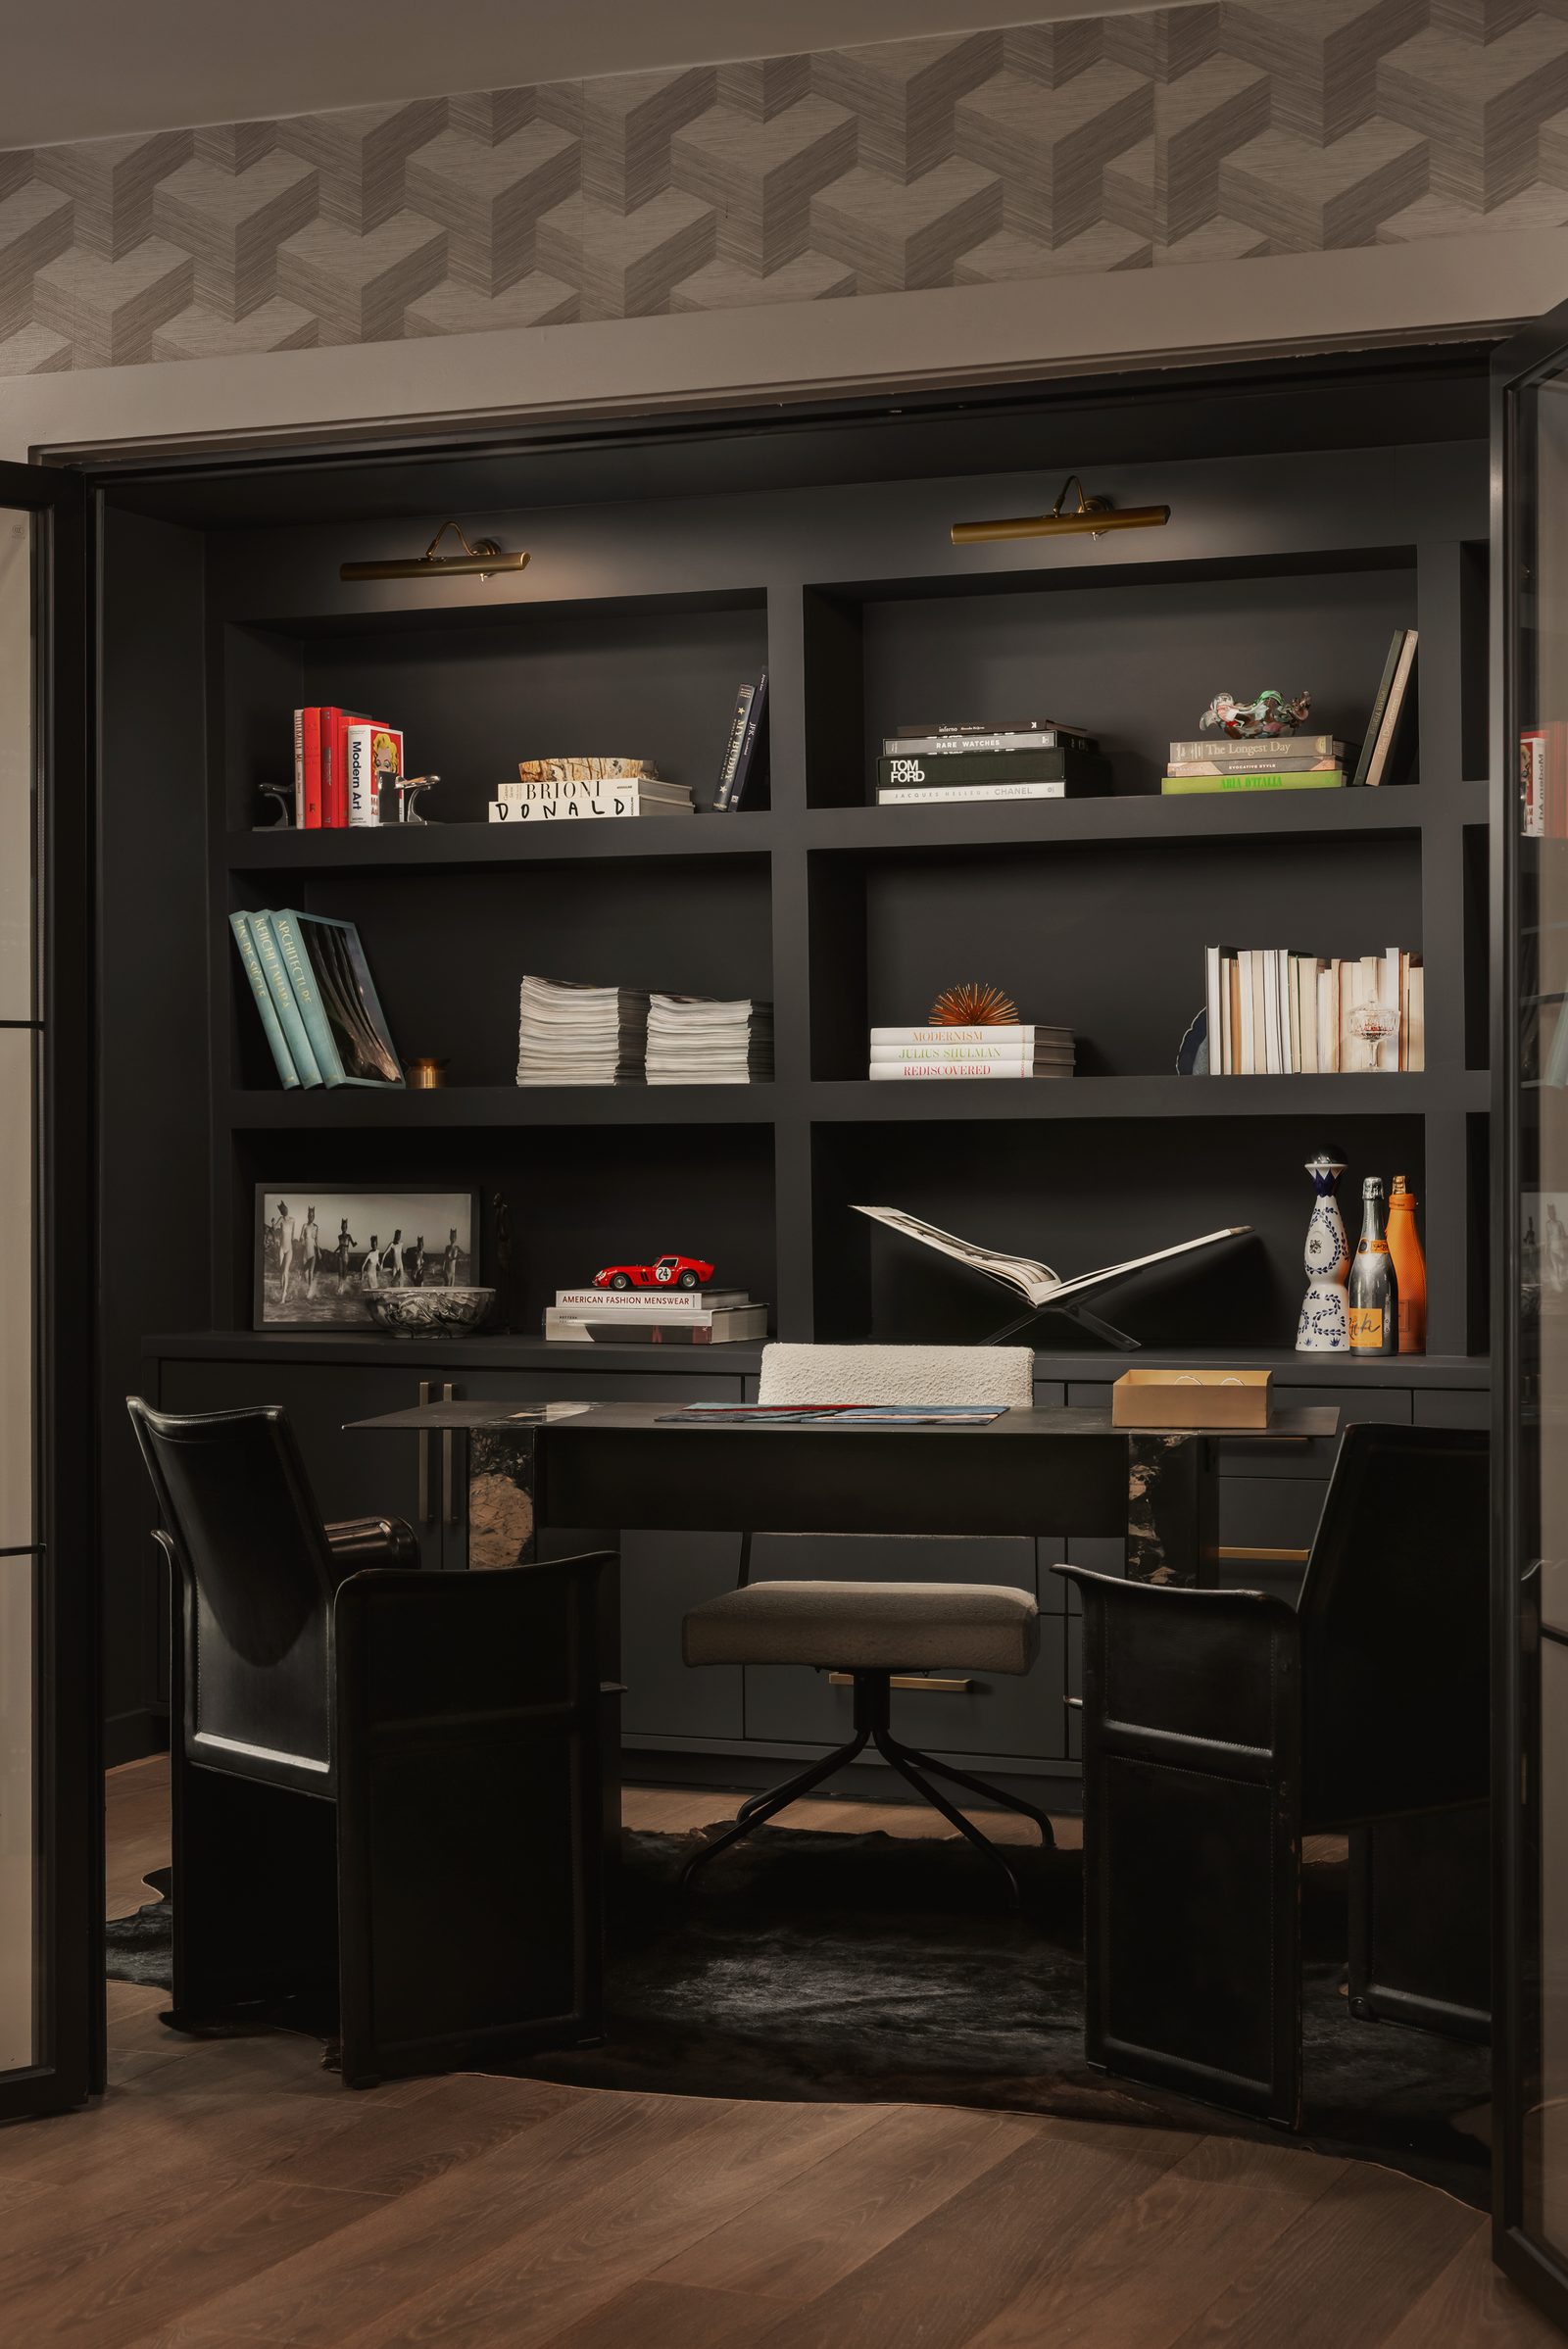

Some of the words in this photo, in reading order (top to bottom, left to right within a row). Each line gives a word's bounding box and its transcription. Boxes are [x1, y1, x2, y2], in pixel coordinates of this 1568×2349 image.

[735, 719, 746, 738] MY
[962, 739, 1001, 749] WATCHES
[1206, 744, 1225, 756] The
[1228, 743, 1267, 759] Longest
[1269, 741, 1292, 755] Day
[353, 741, 362, 788] Modern
[725, 741, 740, 782] BUDDY
[890, 759, 919, 772] TOM
[890, 770, 926, 783] FORD
[1222, 777, 1242, 789] ARIA
[526, 781, 600, 800] BRIONI
[995, 787, 1033, 796] CHANEL
[353, 792, 362, 810] Art
[495, 799, 624, 821] DONALD
[255, 917, 276, 961] KEIICHI
[269, 963, 291, 1010] TAHARA
[276, 919, 312, 1004] ARCHITECTURE
[912, 1031, 984, 1043] MODERNISM
[899, 1049, 940, 1059] JULIUS
[943, 1048, 1002, 1059] SHULMAN
[904, 1065, 991, 1076] REDISCOVERED
[658, 1268, 668, 1280] 24
[562, 1296, 604, 1304] AMERICAN
[606, 1296, 641, 1304] FASHION
[644, 1297, 690, 1305] MENSWEAR
